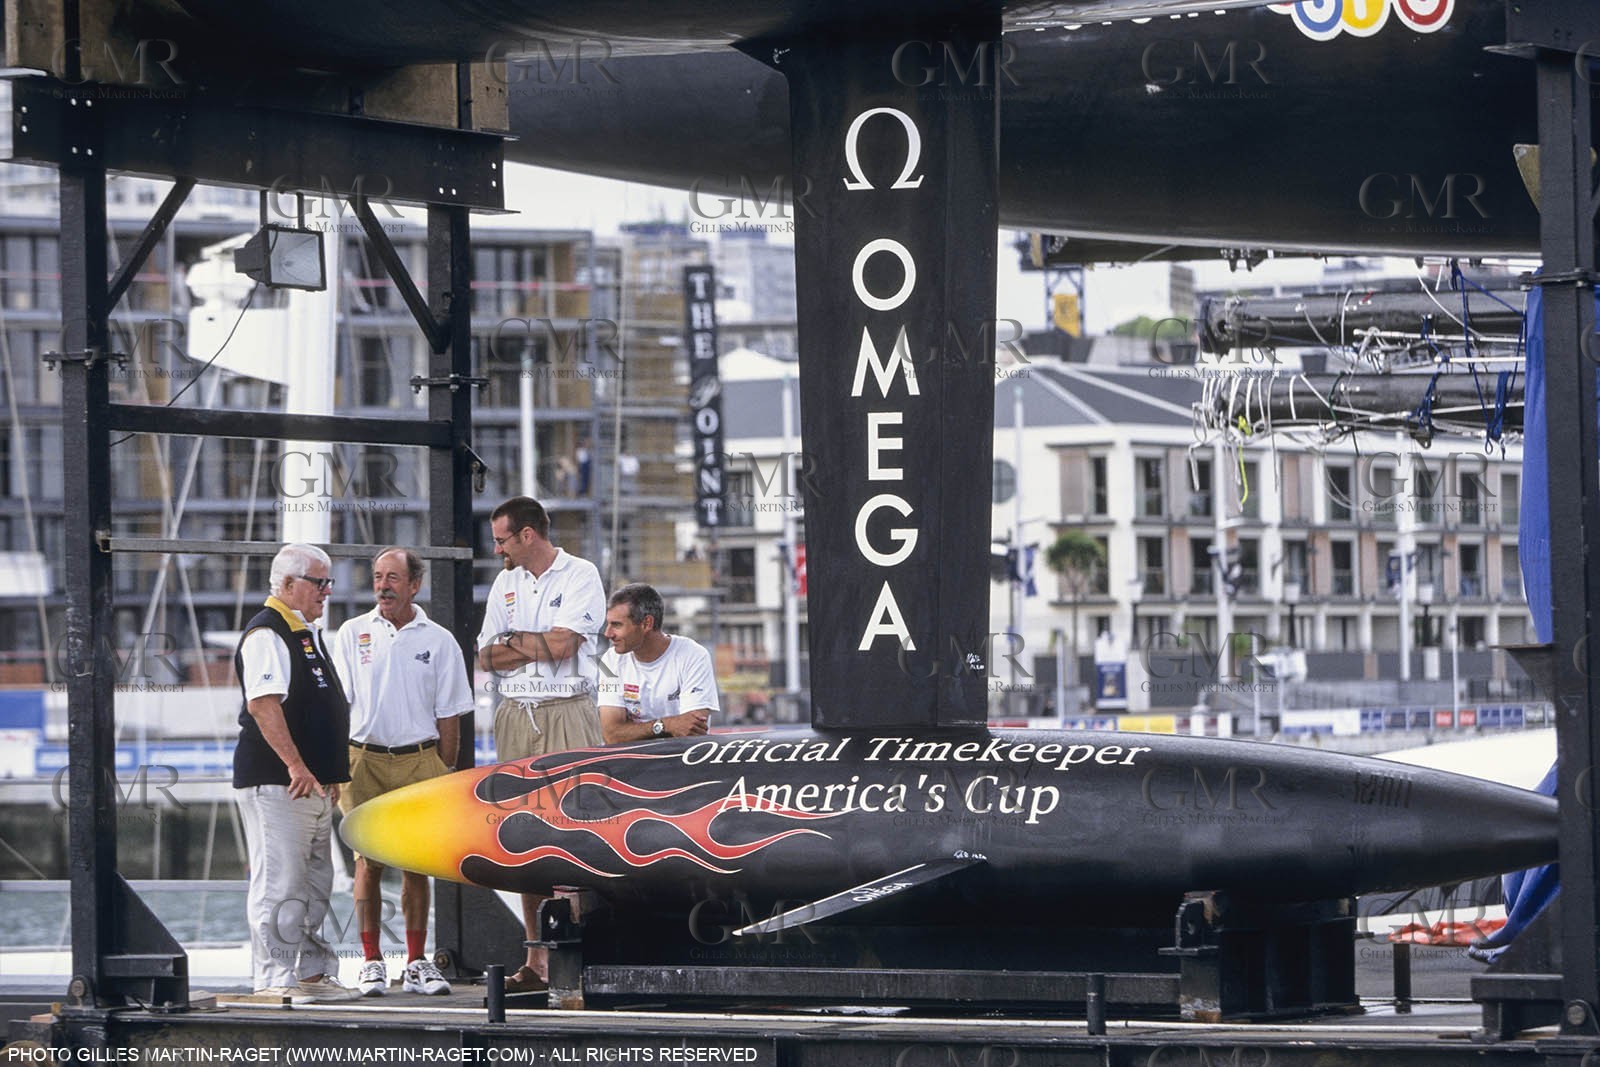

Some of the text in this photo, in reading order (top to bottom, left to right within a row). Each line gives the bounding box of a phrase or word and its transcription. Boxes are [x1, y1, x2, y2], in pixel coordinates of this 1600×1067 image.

[687, 271, 715, 360] THE
[851, 238, 921, 651] OMEGA
[681, 737, 1152, 771] Official Timekeeper
[717, 774, 1061, 825] America's Cup
[853, 882, 913, 902] OMEGA
